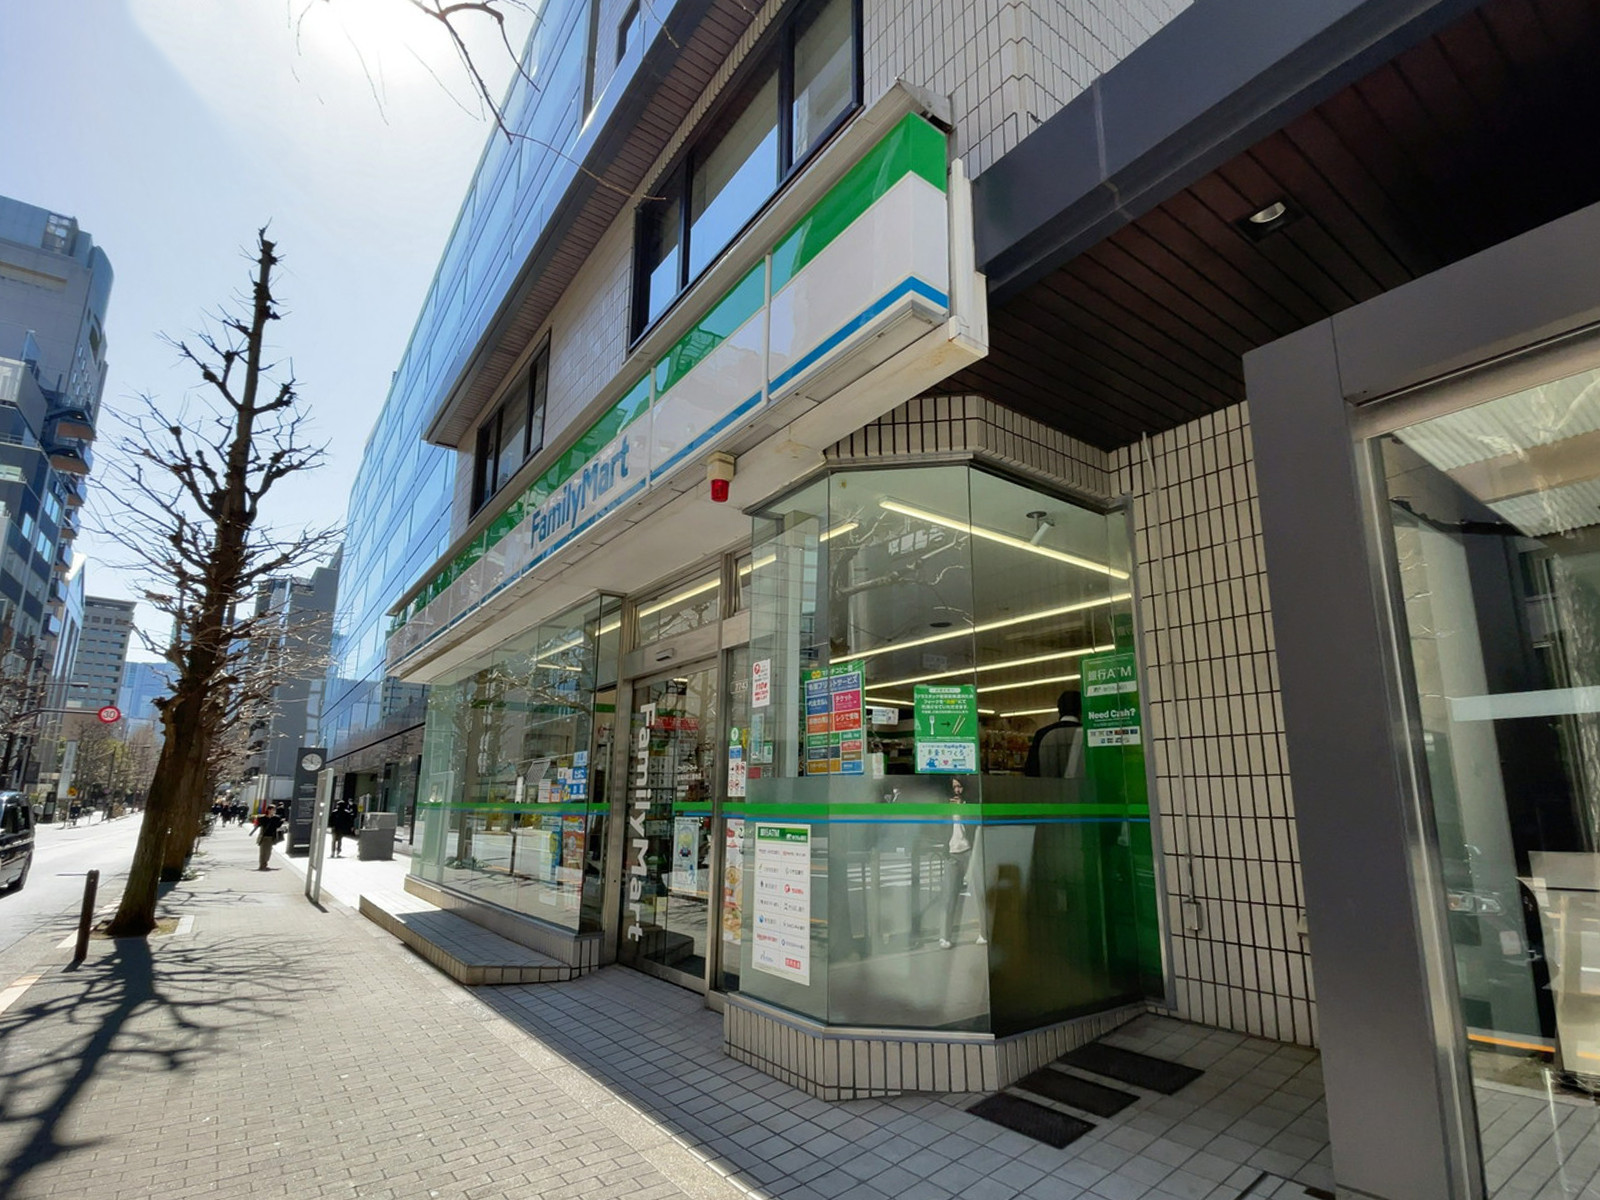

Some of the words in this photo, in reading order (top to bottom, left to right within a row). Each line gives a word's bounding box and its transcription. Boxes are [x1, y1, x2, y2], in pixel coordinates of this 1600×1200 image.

[530, 435, 630, 550] FamilyMart
[1088, 665, 1132, 681] 銀行AM
[103, 710, 116, 719] 30
[1088, 710, 1109, 720] Need
[627, 702, 657, 942] FamilyMart
